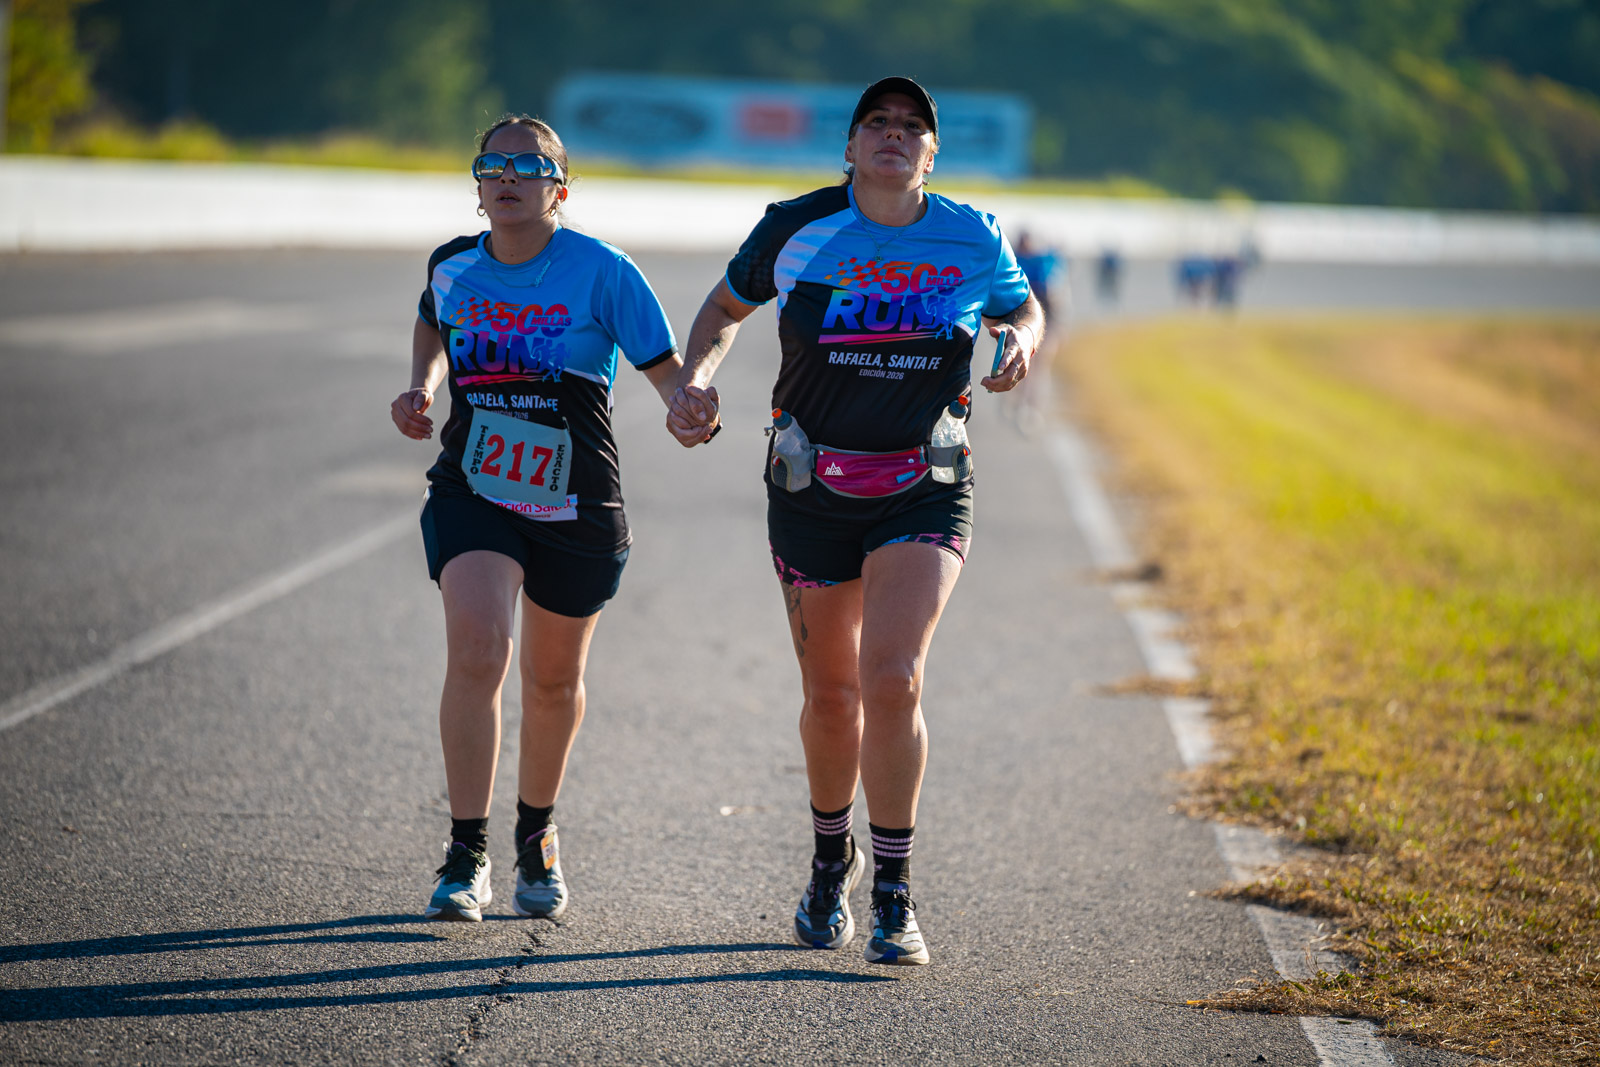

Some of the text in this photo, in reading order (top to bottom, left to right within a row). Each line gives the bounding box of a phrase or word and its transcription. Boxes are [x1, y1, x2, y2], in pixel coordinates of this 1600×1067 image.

[881, 261, 963, 296] 500
[491, 302, 572, 338] 500 MILLAS
[822, 289, 947, 332] RUN
[449, 328, 553, 374] RUN
[828, 351, 943, 370] RAFAELA, SANTA FE
[859, 368, 905, 380] EDICIÓN 2026
[510, 394, 547, 409] SANTA
[470, 424, 489, 475] TIEMPO
[480, 433, 554, 487] 217
[549, 444, 566, 492] EXACTO
